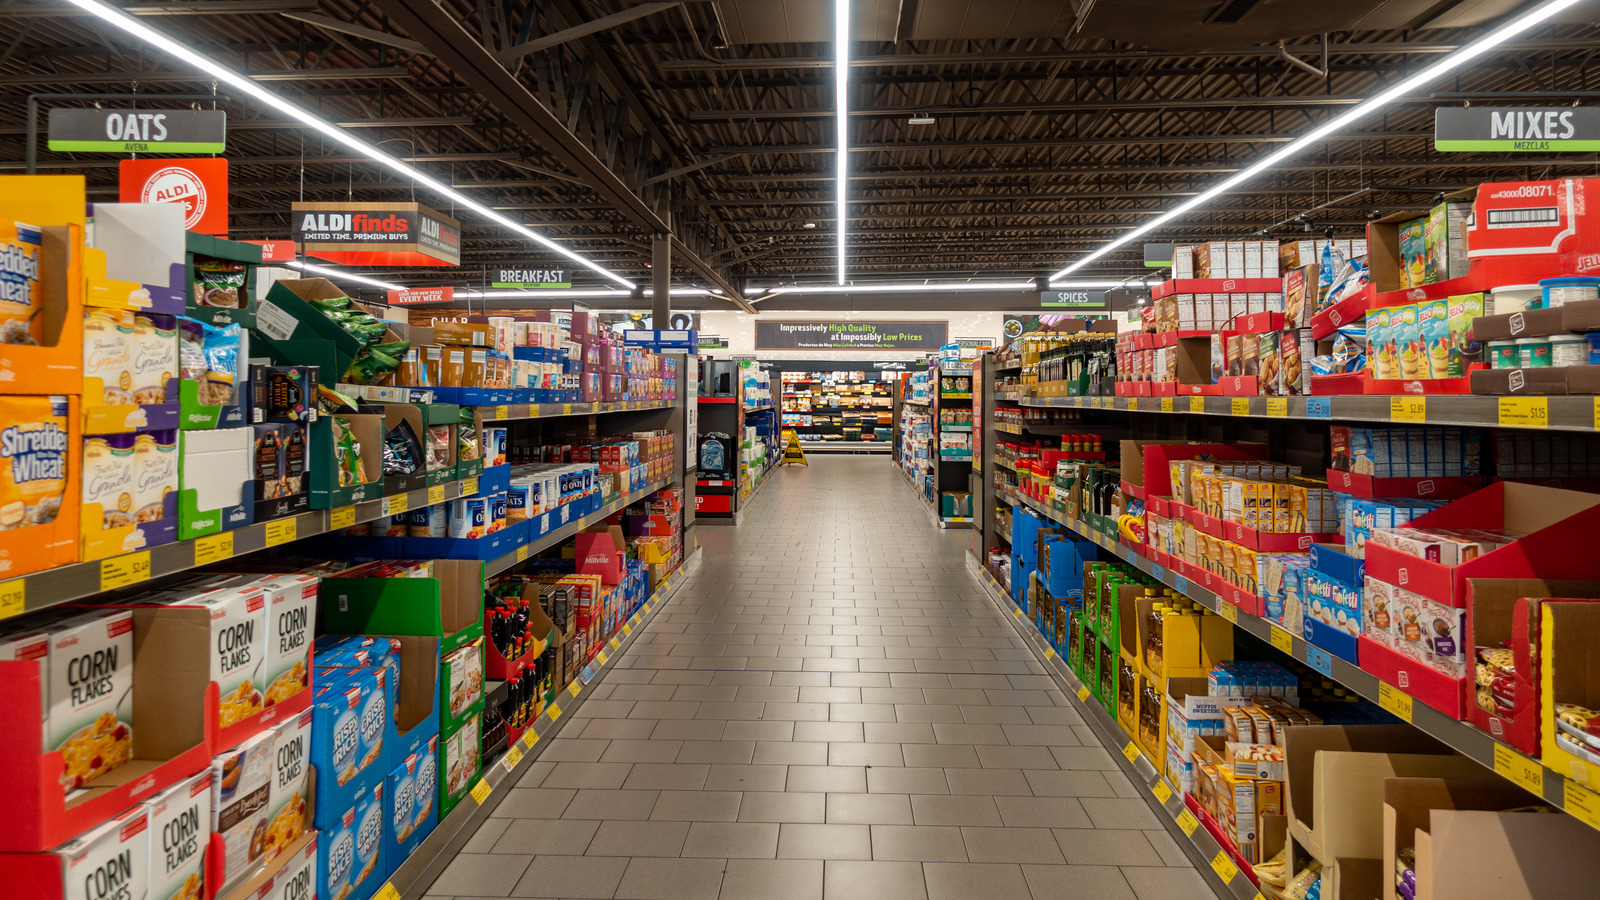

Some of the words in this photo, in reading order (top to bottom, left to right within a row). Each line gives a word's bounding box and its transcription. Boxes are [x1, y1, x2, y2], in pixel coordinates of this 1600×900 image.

[106, 113, 168, 141] OATS
[1491, 111, 1574, 139] MIXES
[124, 143, 148, 151] AVENA
[1514, 141, 1550, 150] MEZCLAS
[156, 184, 189, 202] ALDI
[389, 233, 409, 241] BUYS
[0, 245, 39, 282] edded
[500, 270, 564, 282] BREAKFAST
[1058, 293, 1088, 302] SPICES
[780, 324, 828, 333] Impressively
[829, 324, 847, 333] High
[848, 324, 877, 333] Quality
[840, 333, 882, 342] Impossibly
[883, 333, 898, 341] Low
[899, 333, 923, 341] Prices
[1530, 407, 1546, 419] $1.15
[12, 451, 65, 485] Wheat
[137, 460, 174, 494] Granola
[89, 465, 132, 501] Granola
[412, 514, 426, 522] ATS
[585, 557, 609, 565] Millville
[1308, 577, 1331, 599] Funfetti
[1332, 585, 1358, 610] Funfetti
[279, 605, 307, 637] CORN
[218, 619, 254, 655] CORN
[280, 630, 305, 654] FLAKES
[68, 645, 118, 686] CORN
[221, 646, 250, 674] FLAKES
[72, 675, 113, 707] FLAKES
[333, 714, 359, 752] RISPY
[366, 714, 385, 739] RICE
[277, 735, 303, 771] CORN
[335, 735, 356, 767] RICE
[279, 760, 302, 789] FLAKES
[420, 773, 436, 800] RICE
[395, 779, 414, 812] RISPY
[395, 795, 413, 826] RICE
[162, 803, 199, 853] CORN
[363, 827, 381, 856] RICE
[166, 834, 198, 874] FLAKES
[329, 831, 353, 872] RISPY
[85, 848, 131, 899] CORN
[284, 863, 311, 900] CORN
[330, 853, 351, 889] RICE
